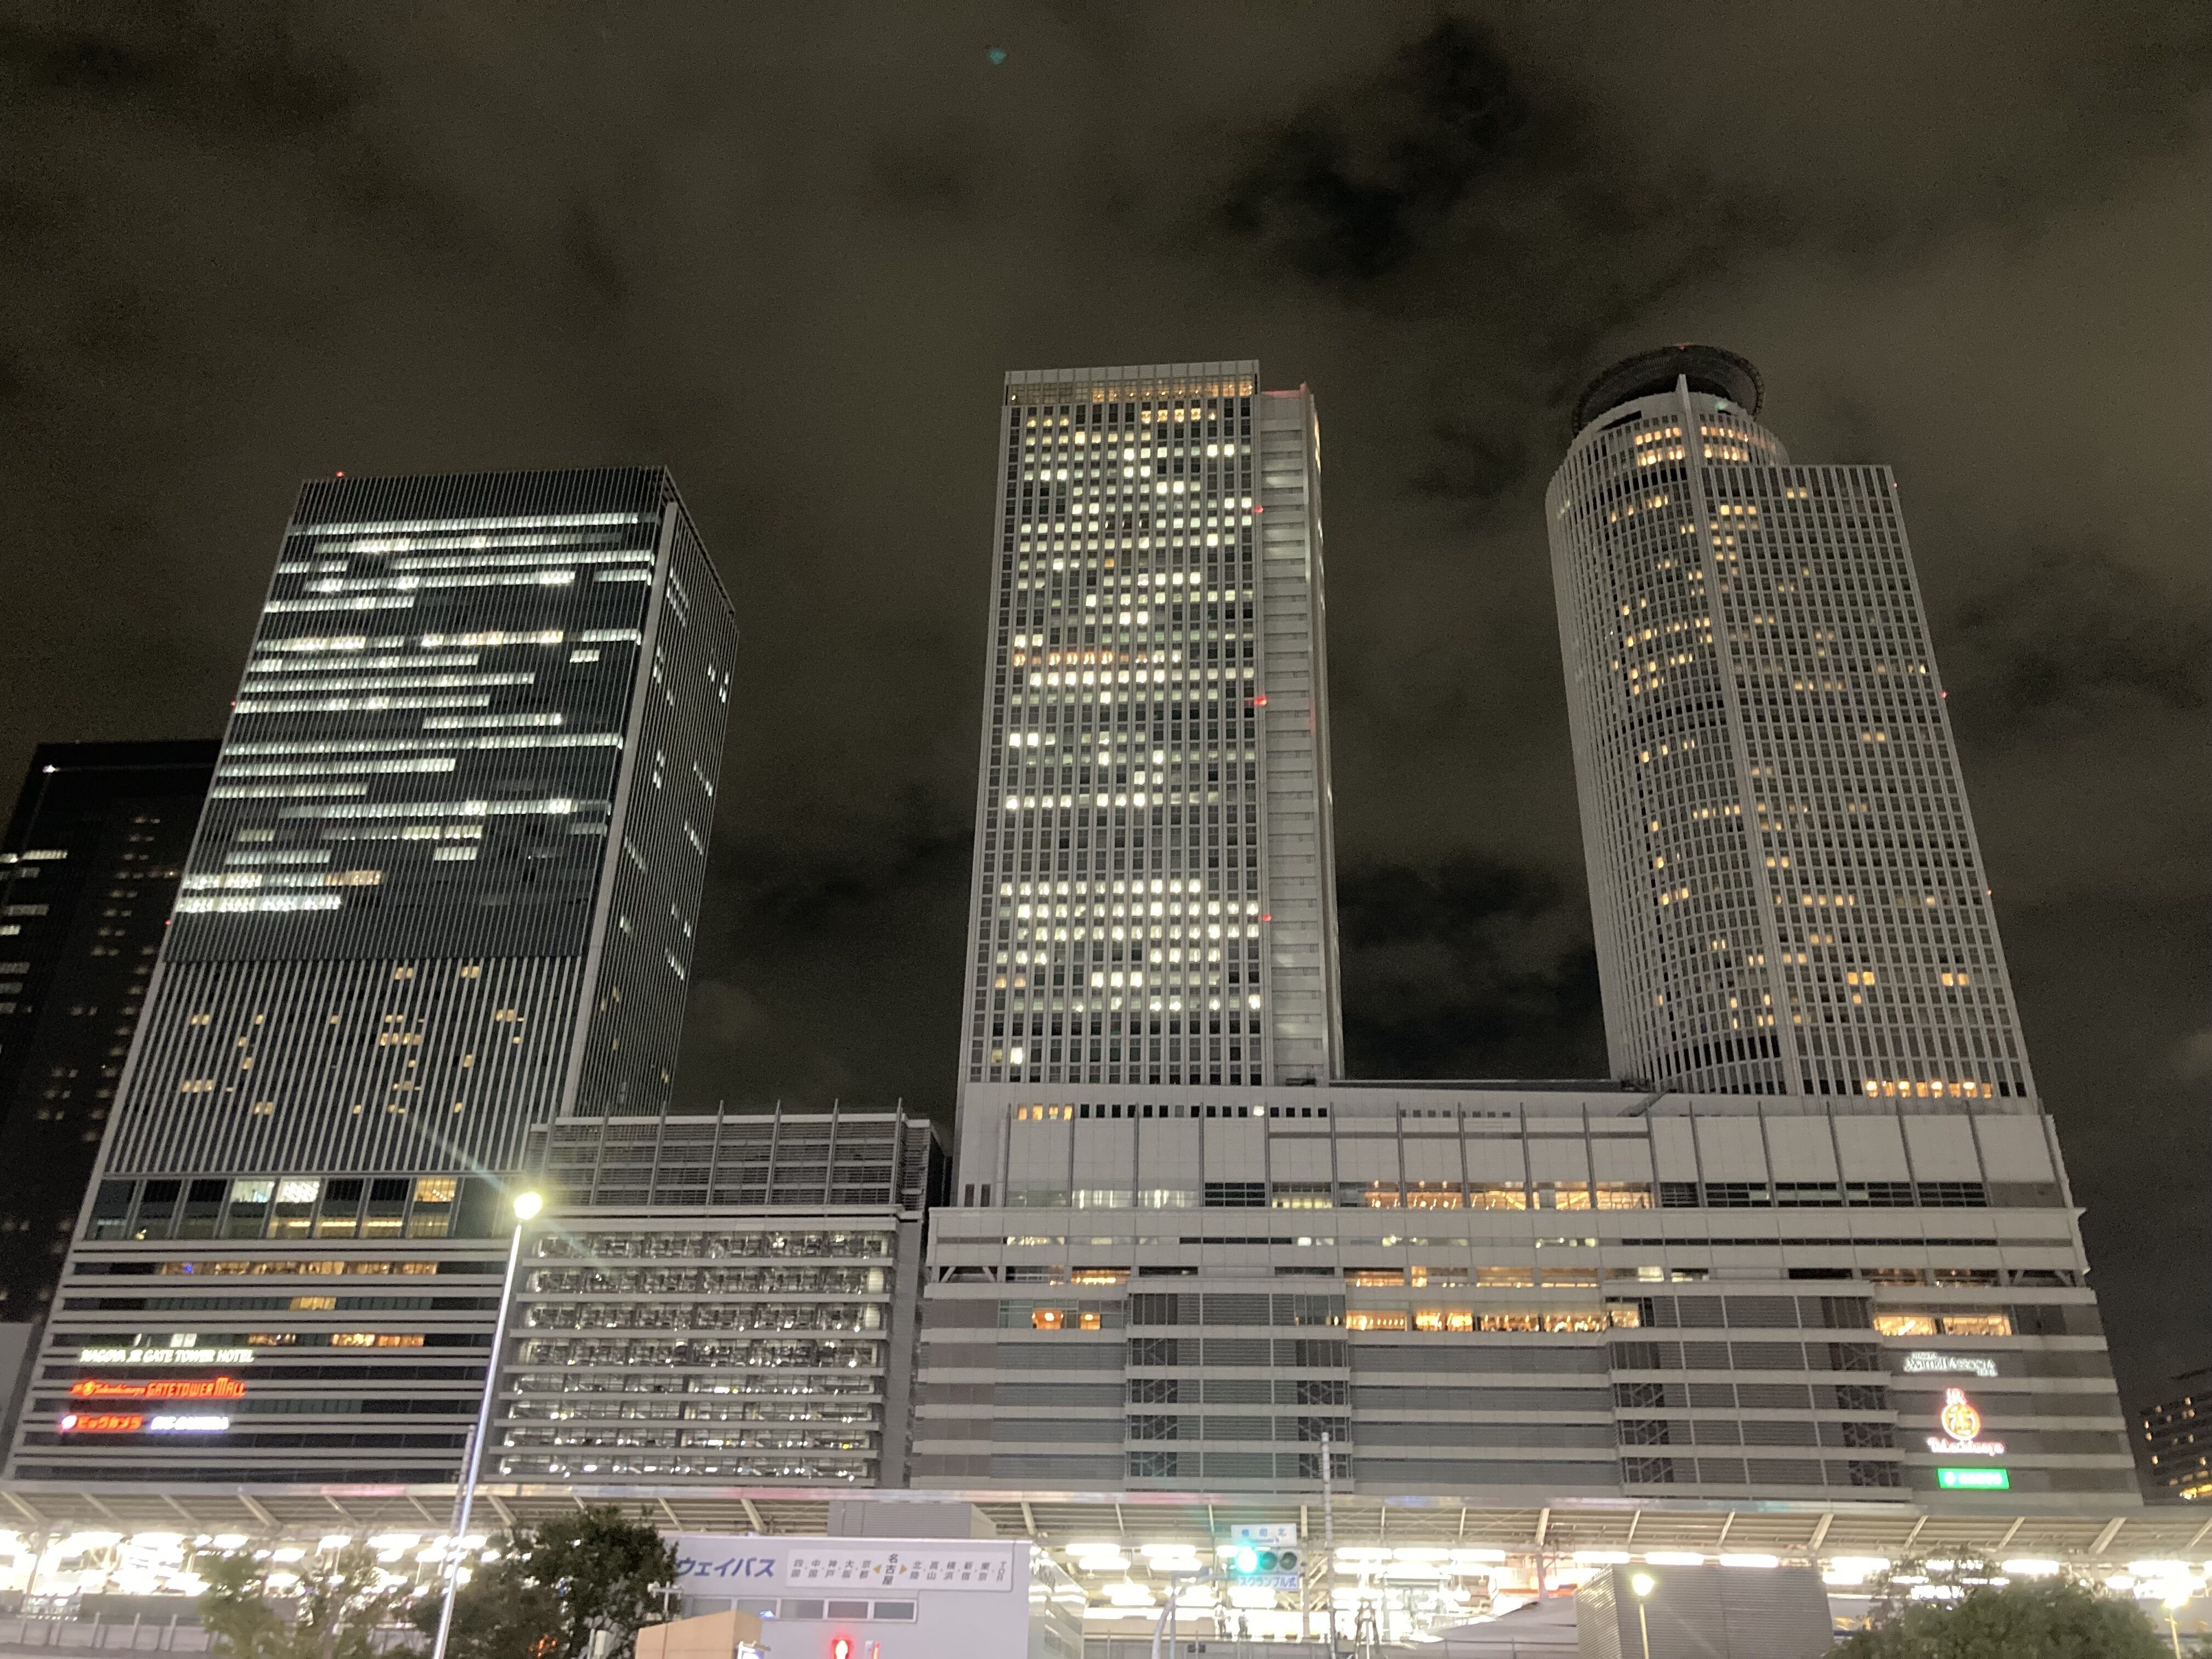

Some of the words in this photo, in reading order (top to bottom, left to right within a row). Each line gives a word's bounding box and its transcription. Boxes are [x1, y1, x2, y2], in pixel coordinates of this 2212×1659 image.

[143, 1349, 174, 1363] GATE
[175, 1349, 216, 1363] TOWER
[216, 1349, 255, 1363] HOTEL
[882, 1554, 898, 1585] 名古屋
